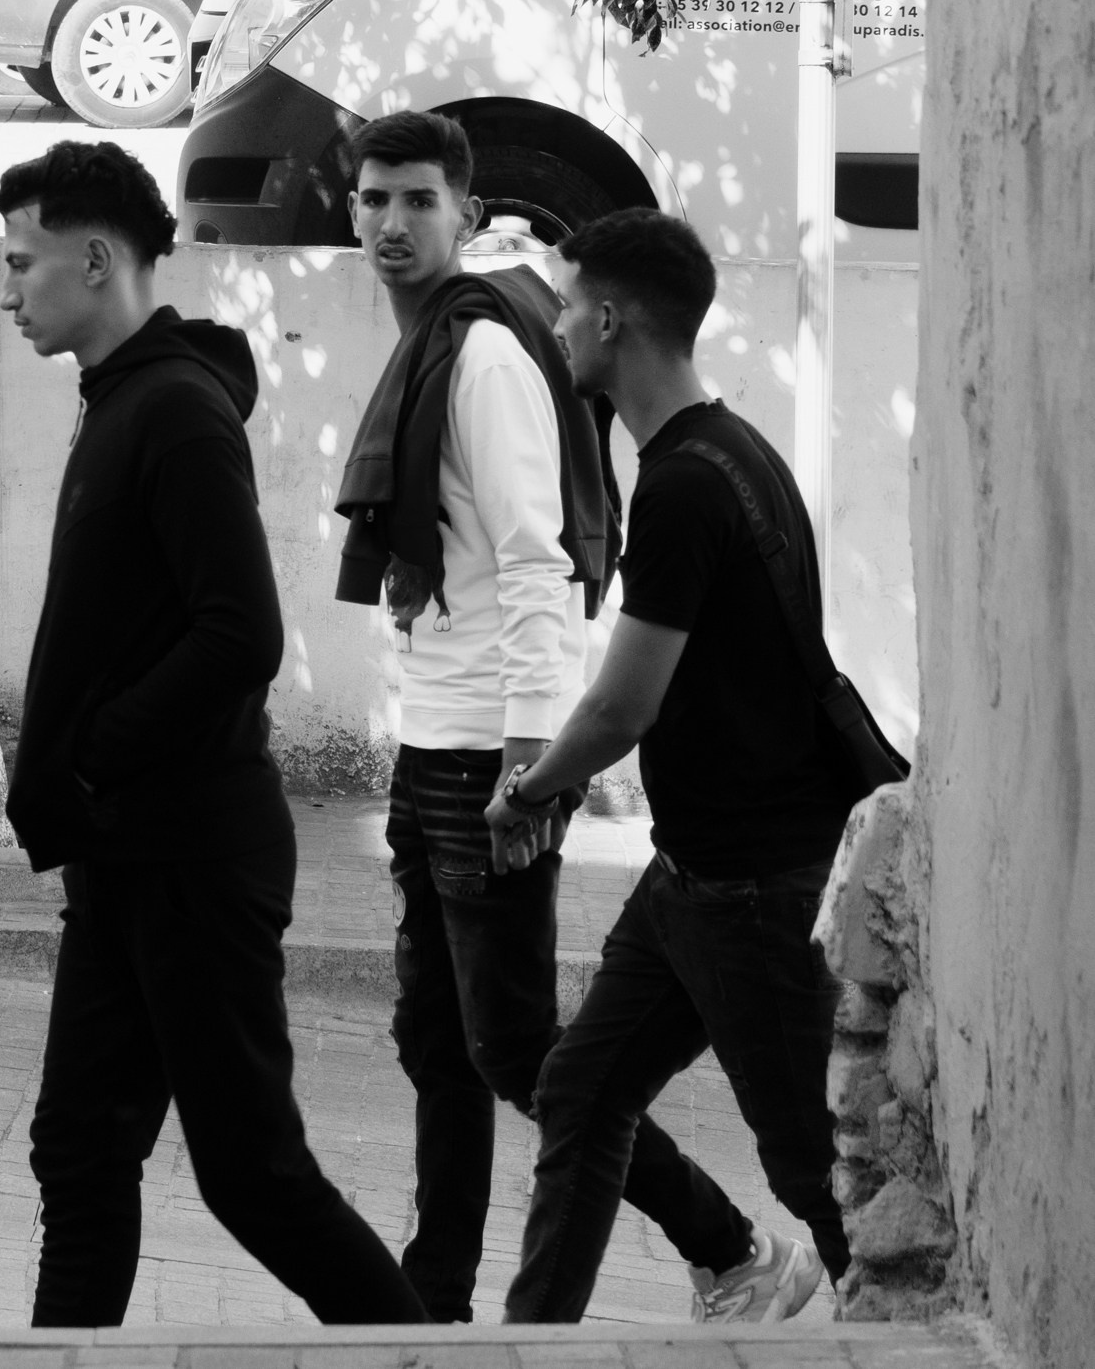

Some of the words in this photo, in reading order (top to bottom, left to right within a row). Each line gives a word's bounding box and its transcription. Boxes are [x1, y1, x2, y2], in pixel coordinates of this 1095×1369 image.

[716, 0, 735, 12] 30
[741, 0, 760, 13] 12
[765, 1, 784, 14] 12
[874, 5, 893, 17] 12
[898, 6, 918, 18] 14
[712, 452, 768, 535] LACOSTE
